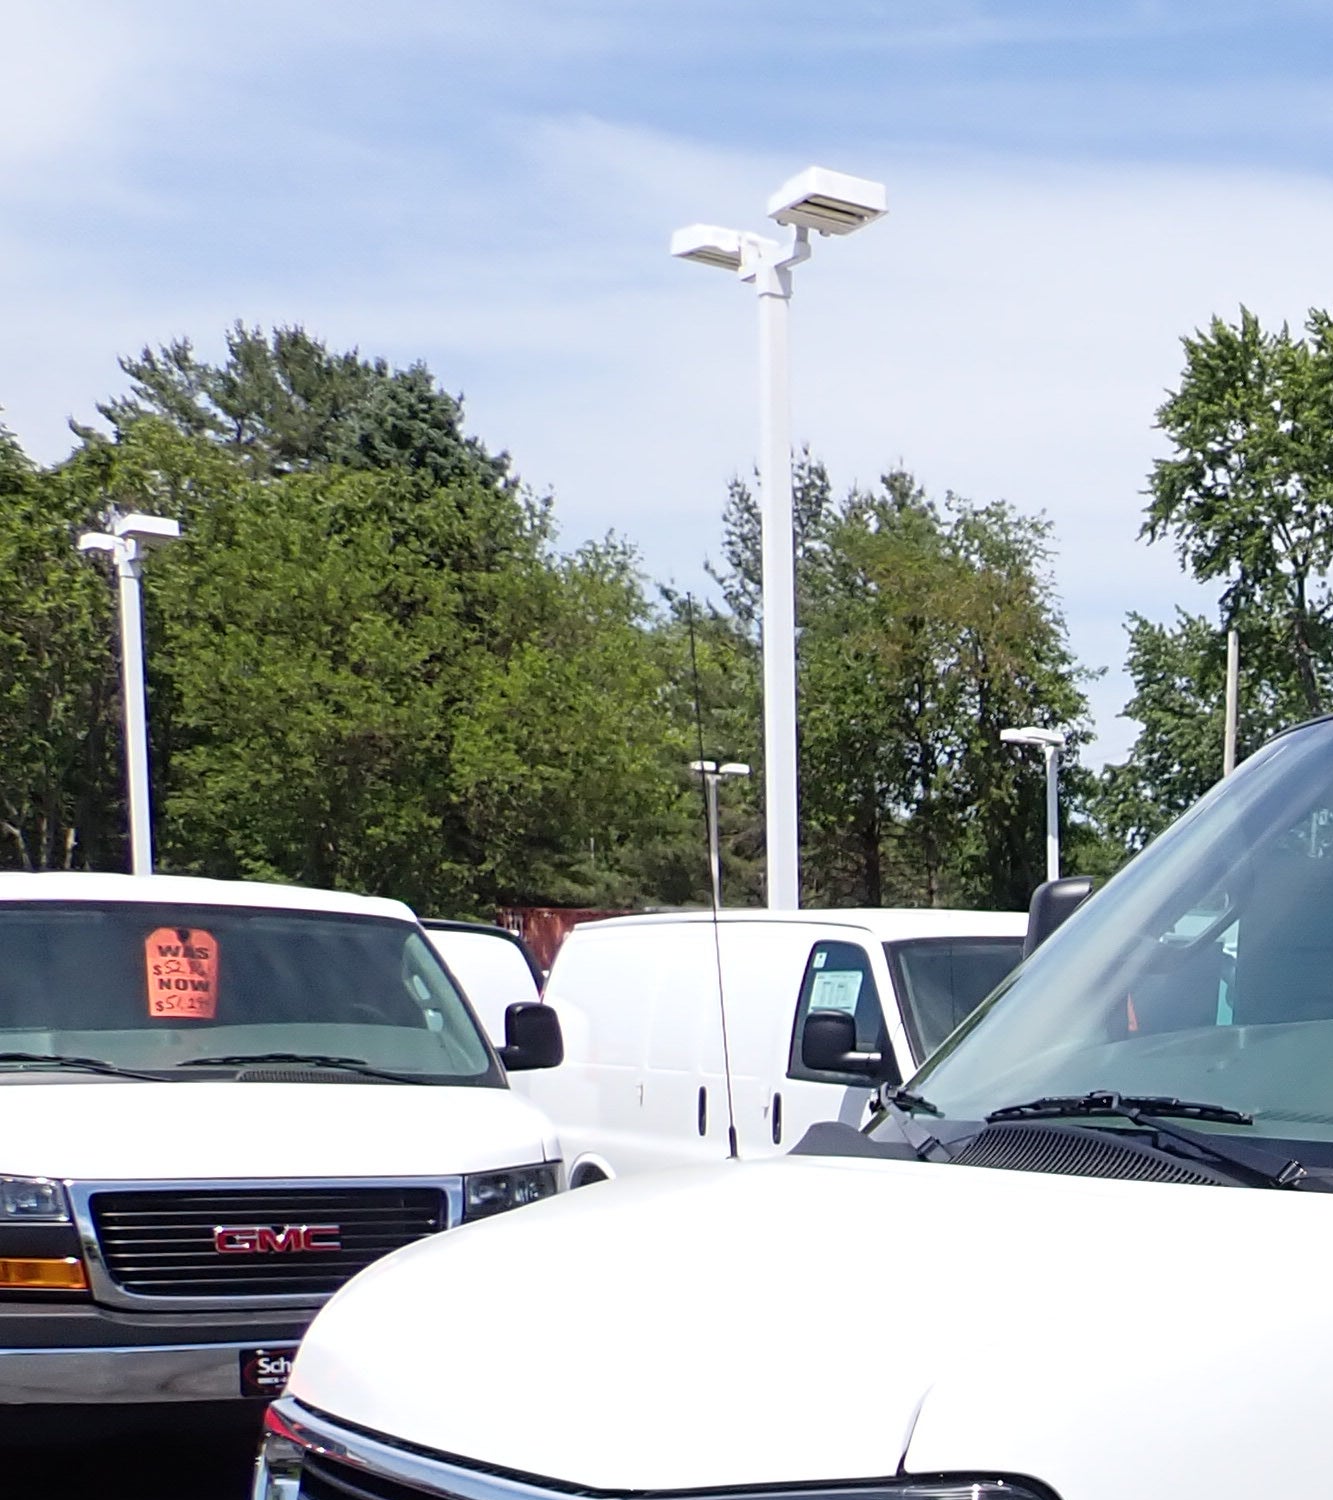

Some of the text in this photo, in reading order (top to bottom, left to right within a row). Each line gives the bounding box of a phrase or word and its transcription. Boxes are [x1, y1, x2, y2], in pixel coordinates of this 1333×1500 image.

[157, 945, 209, 960] WAS
[158, 979, 210, 992] NOW
[214, 1225, 341, 1254] GMC
